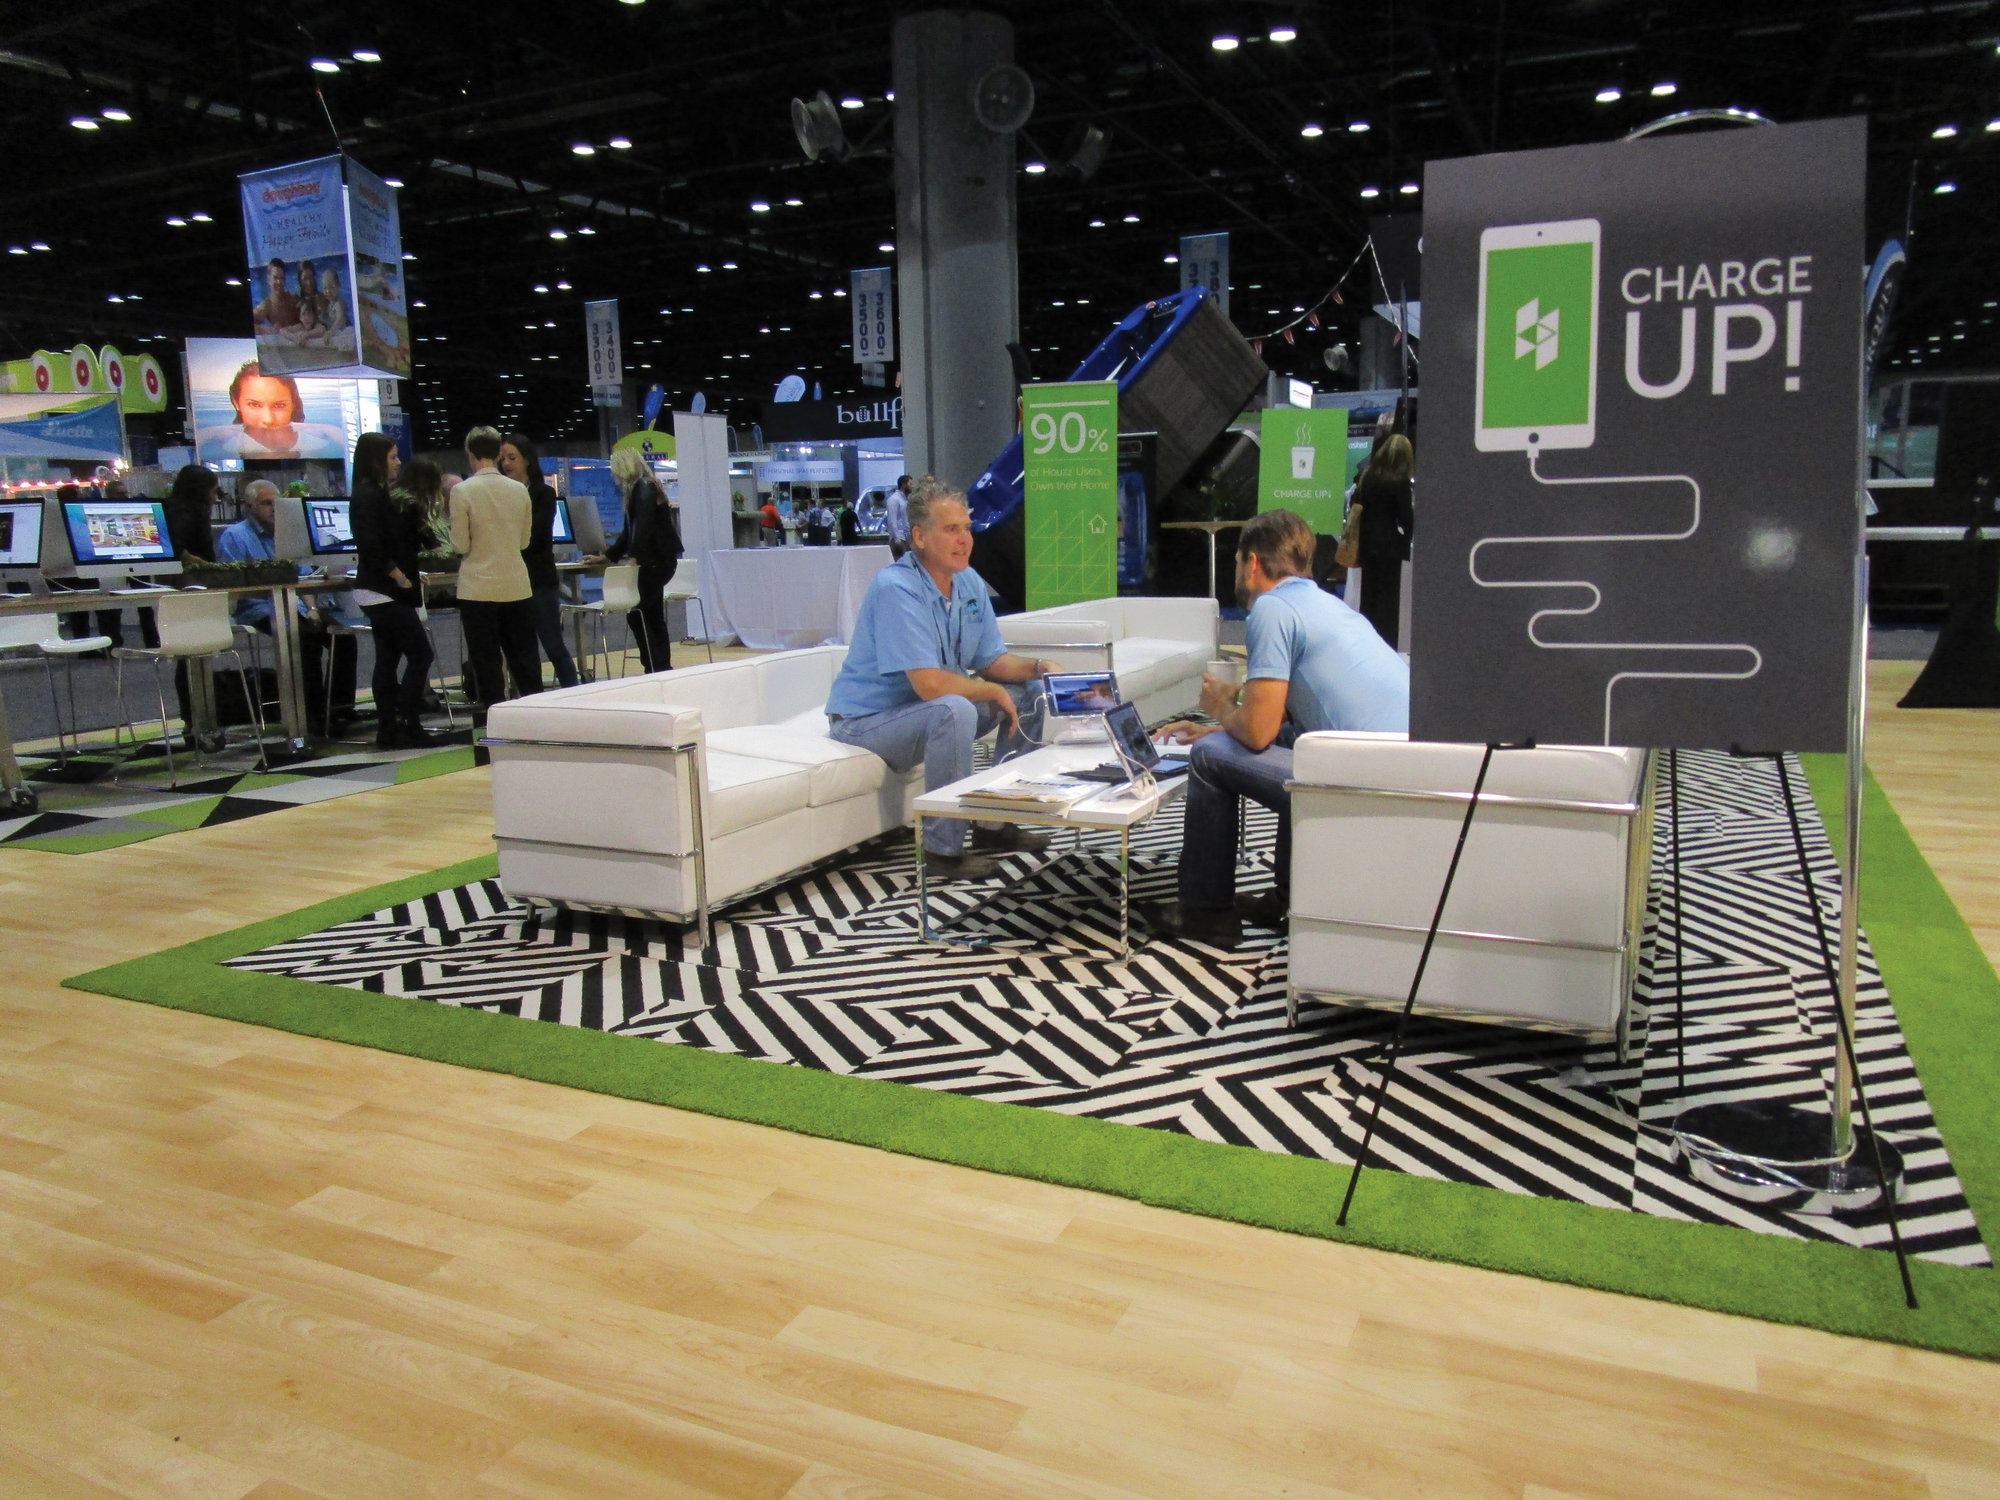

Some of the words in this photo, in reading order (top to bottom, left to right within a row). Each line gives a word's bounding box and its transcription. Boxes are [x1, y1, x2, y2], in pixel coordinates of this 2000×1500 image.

[1621, 255, 1812, 304] CHARGE
[859, 293, 869, 351] 3500
[876, 292, 886, 350] 3600
[592, 323, 602, 375] 3300
[606, 321, 616, 374] 3400
[1625, 300, 1803, 399] UP!
[1031, 412, 1109, 455] 90%
[1031, 466, 1039, 477] of
[1076, 465, 1103, 477] Users
[1031, 482, 1054, 491] Own
[1057, 481, 1077, 490] their
[1080, 481, 1110, 490] Home
[1273, 489, 1312, 499] CHARGE
